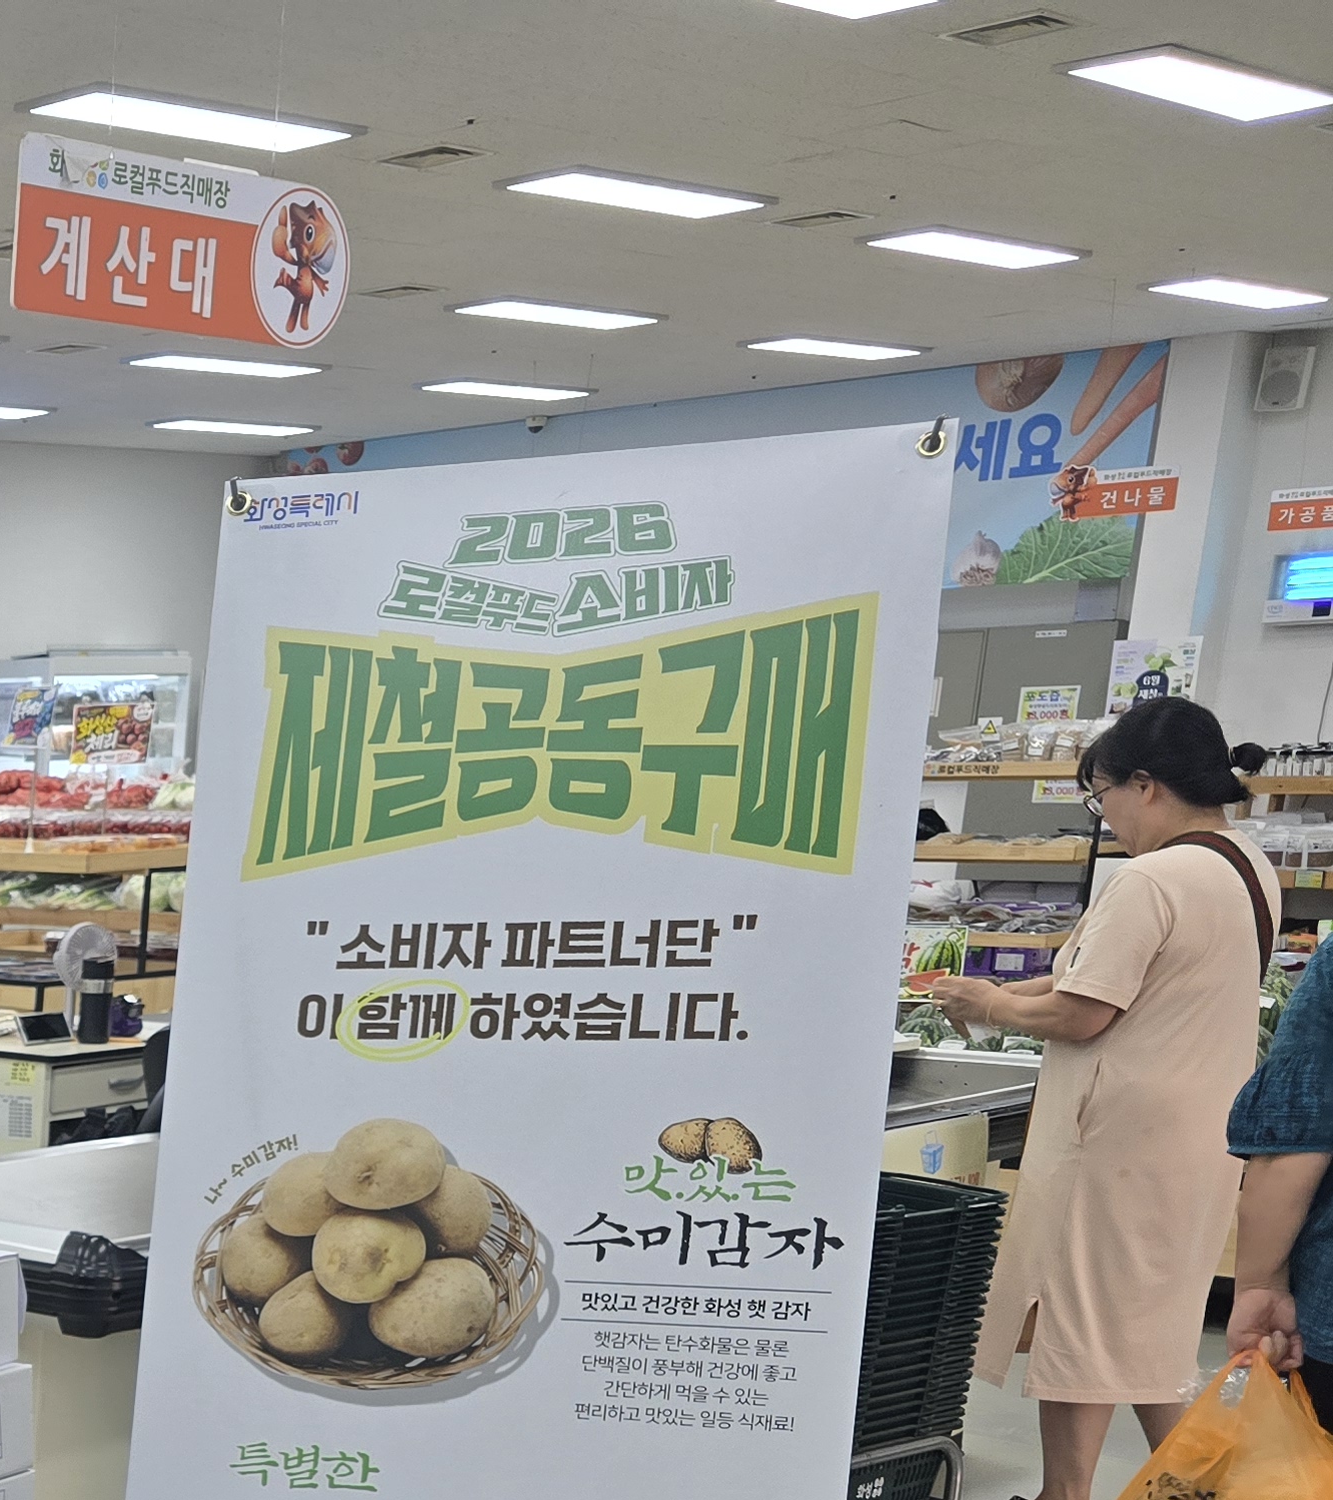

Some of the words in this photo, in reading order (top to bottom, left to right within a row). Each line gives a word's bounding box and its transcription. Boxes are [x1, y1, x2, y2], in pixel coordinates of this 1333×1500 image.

[111, 161, 230, 209] 로컬푸드직매장
[40, 215, 218, 319] 계산대
[1100, 486, 1166, 510] 건나물
[450, 504, 674, 565] 2026
[384, 564, 557, 632] 로컬푸드
[557, 559, 732, 632] 소비자
[255, 608, 860, 867] 제철공동구매
[357, 993, 454, 1041] 함께
[470, 992, 748, 1042] 하였습니다.
[563, 1210, 844, 1270] 수미감자
[582, 1293, 637, 1312] 맛있고
[642, 1295, 699, 1316] 건강한
[703, 1297, 742, 1318] 화성
[747, 1299, 766, 1319] 햇
[772, 1301, 811, 1321] 감자
[582, 1355, 648, 1375] 단백질이
[651, 1358, 703, 1378] 풍부해
[707, 1362, 759, 1381] 건강에
[762, 1365, 797, 1382] 좋고
[595, 1331, 661, 1350] 햇감자는
[665, 1334, 751, 1355] 탄수화물은
[754, 1339, 789, 1358] 물론
[574, 1403, 640, 1422] 편리하고
[645, 1407, 695, 1427] 맛있는
[700, 1411, 734, 1429] 일등
[738, 1413, 794, 1432] 식재료!
[604, 1381, 671, 1400] 간단하게
[675, 1385, 709, 1402] 먹을
[713, 1387, 729, 1404] 수
[735, 1388, 769, 1406] 있는
[230, 1443, 379, 1493] 특별한
